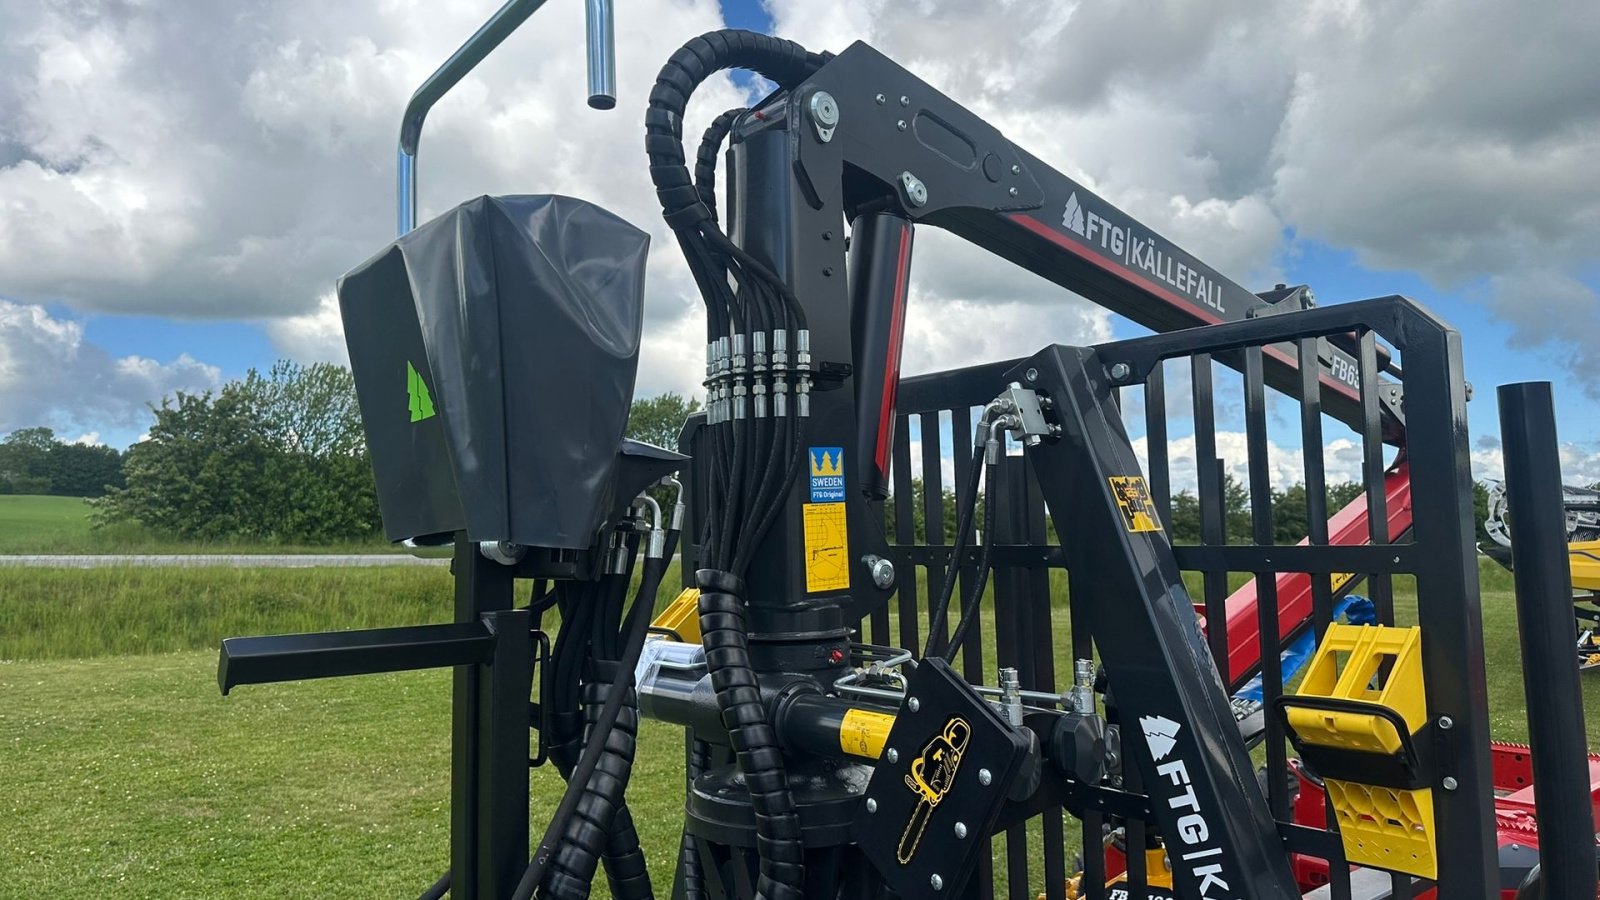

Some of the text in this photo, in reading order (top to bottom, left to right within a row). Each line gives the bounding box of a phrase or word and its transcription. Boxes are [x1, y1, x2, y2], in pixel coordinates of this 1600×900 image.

[1086, 210, 1226, 313] FTG KÄLLEFALL
[812, 477, 843, 487] SWEDEN
[824, 490, 844, 499] Original
[1156, 759, 1210, 845] FTG
